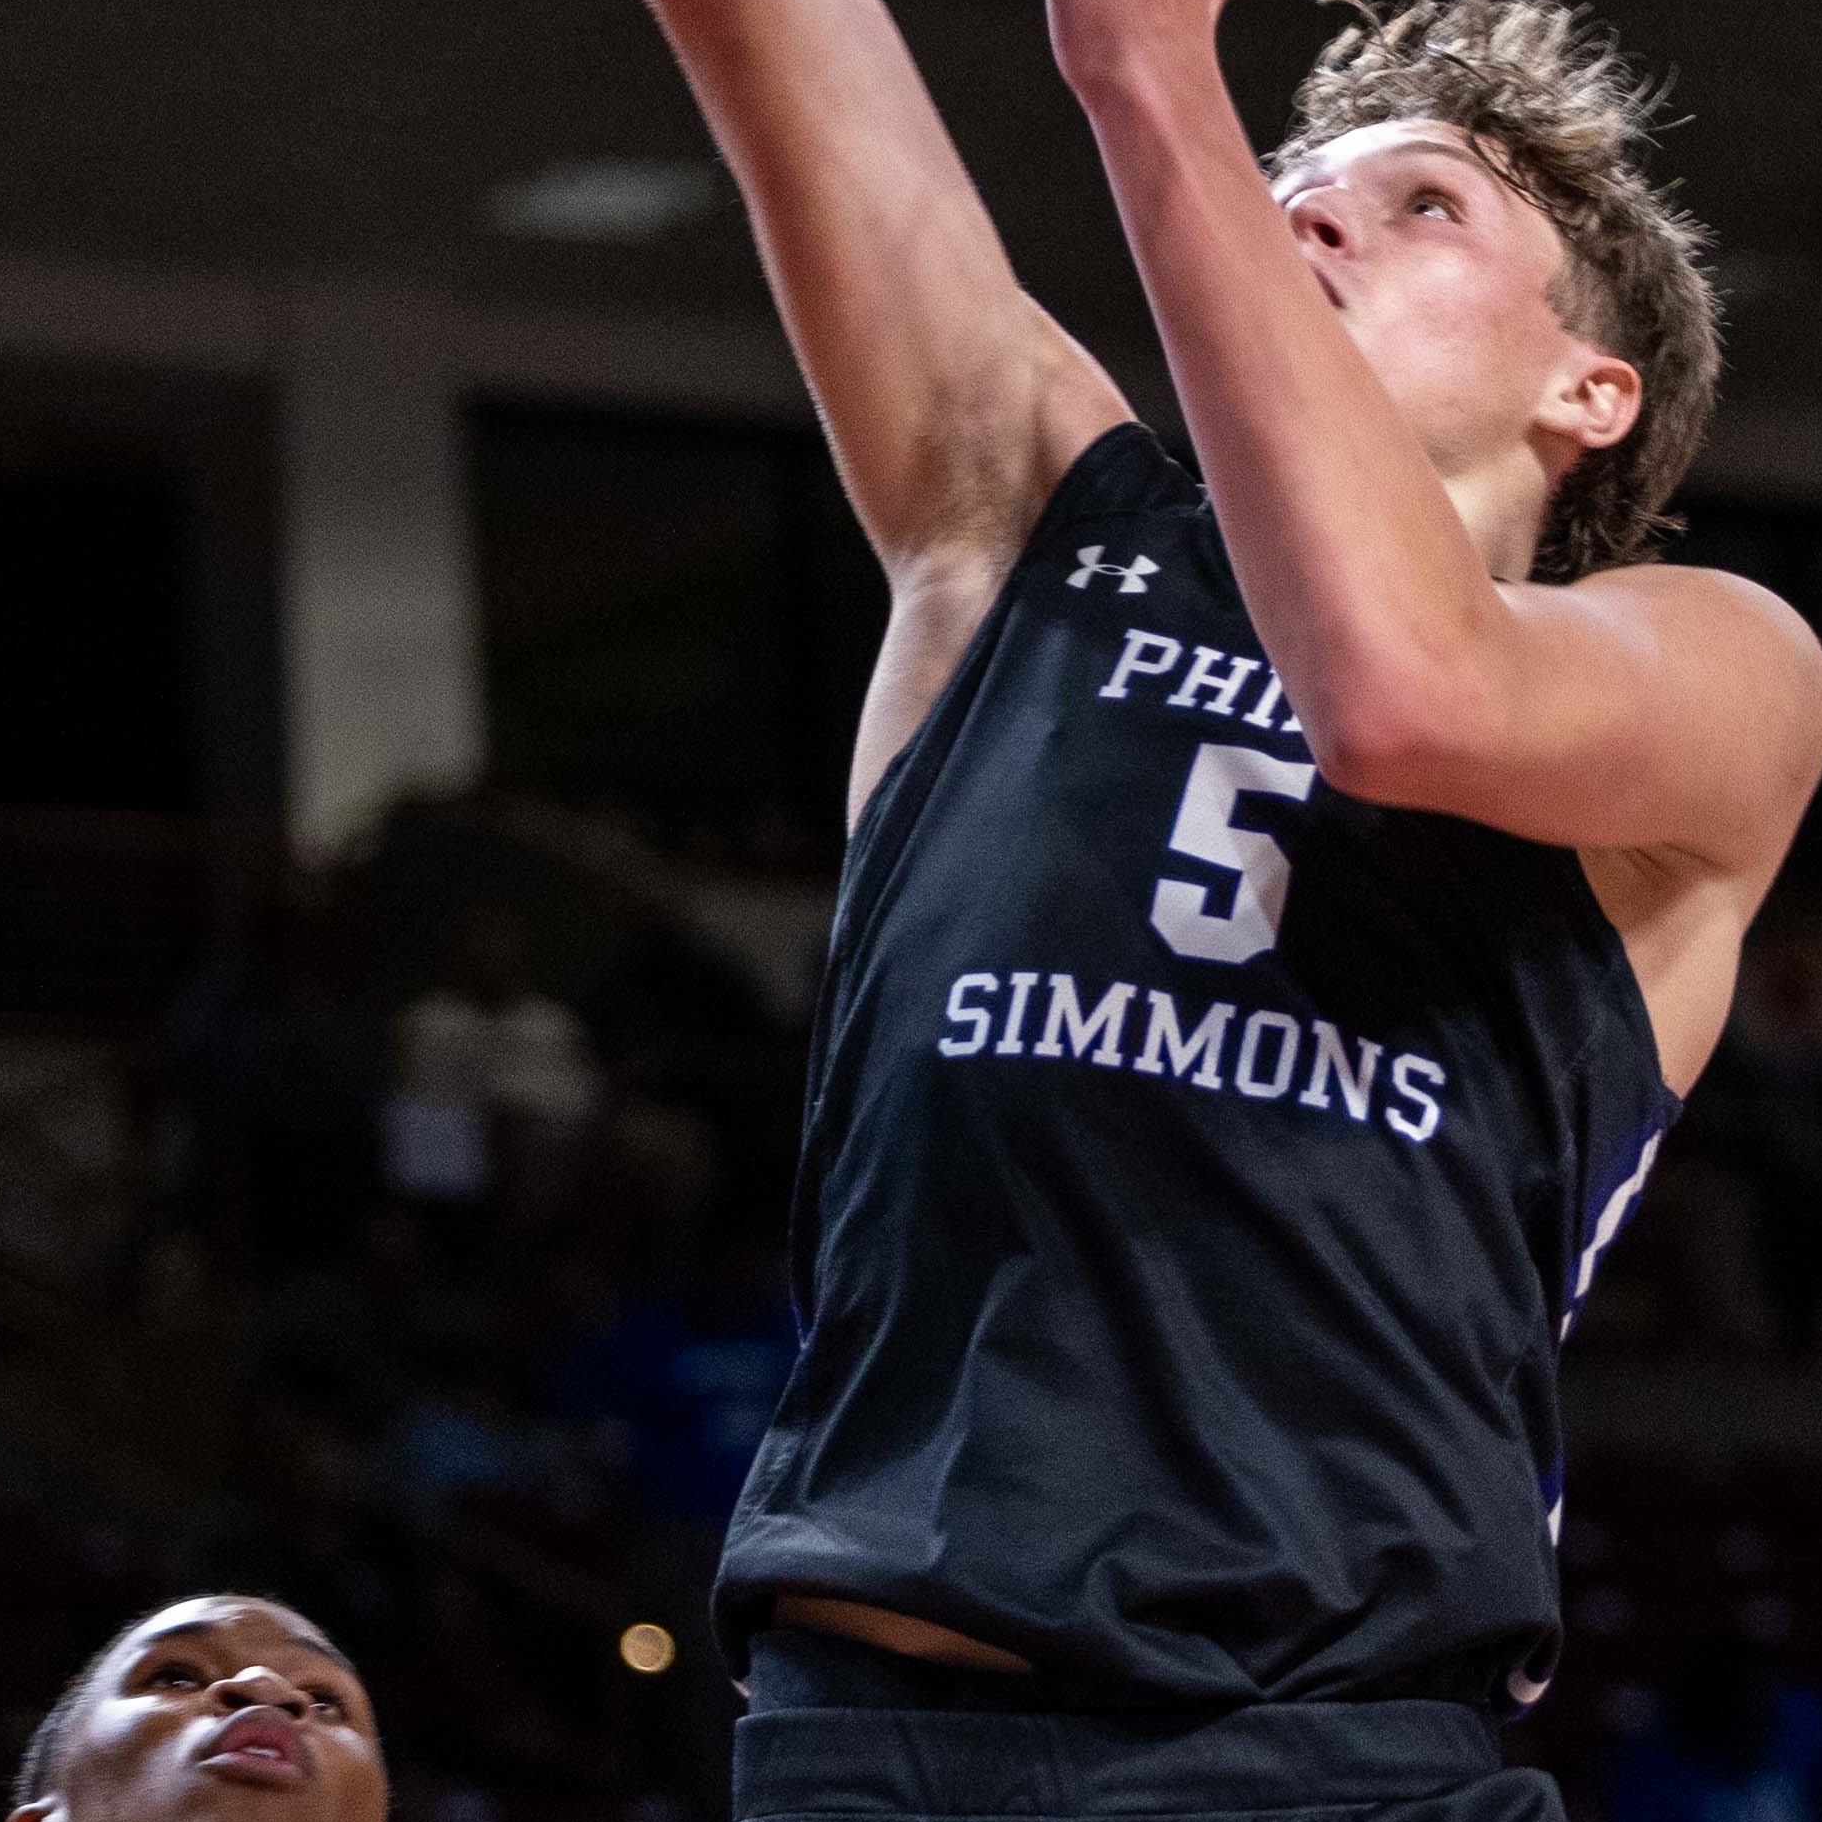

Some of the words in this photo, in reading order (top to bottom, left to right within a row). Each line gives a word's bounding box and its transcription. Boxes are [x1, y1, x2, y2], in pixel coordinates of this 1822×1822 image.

[1097, 628, 1303, 734] PHI
[1148, 742, 1317, 966] 5
[937, 972, 1446, 1142] SIMMONS
